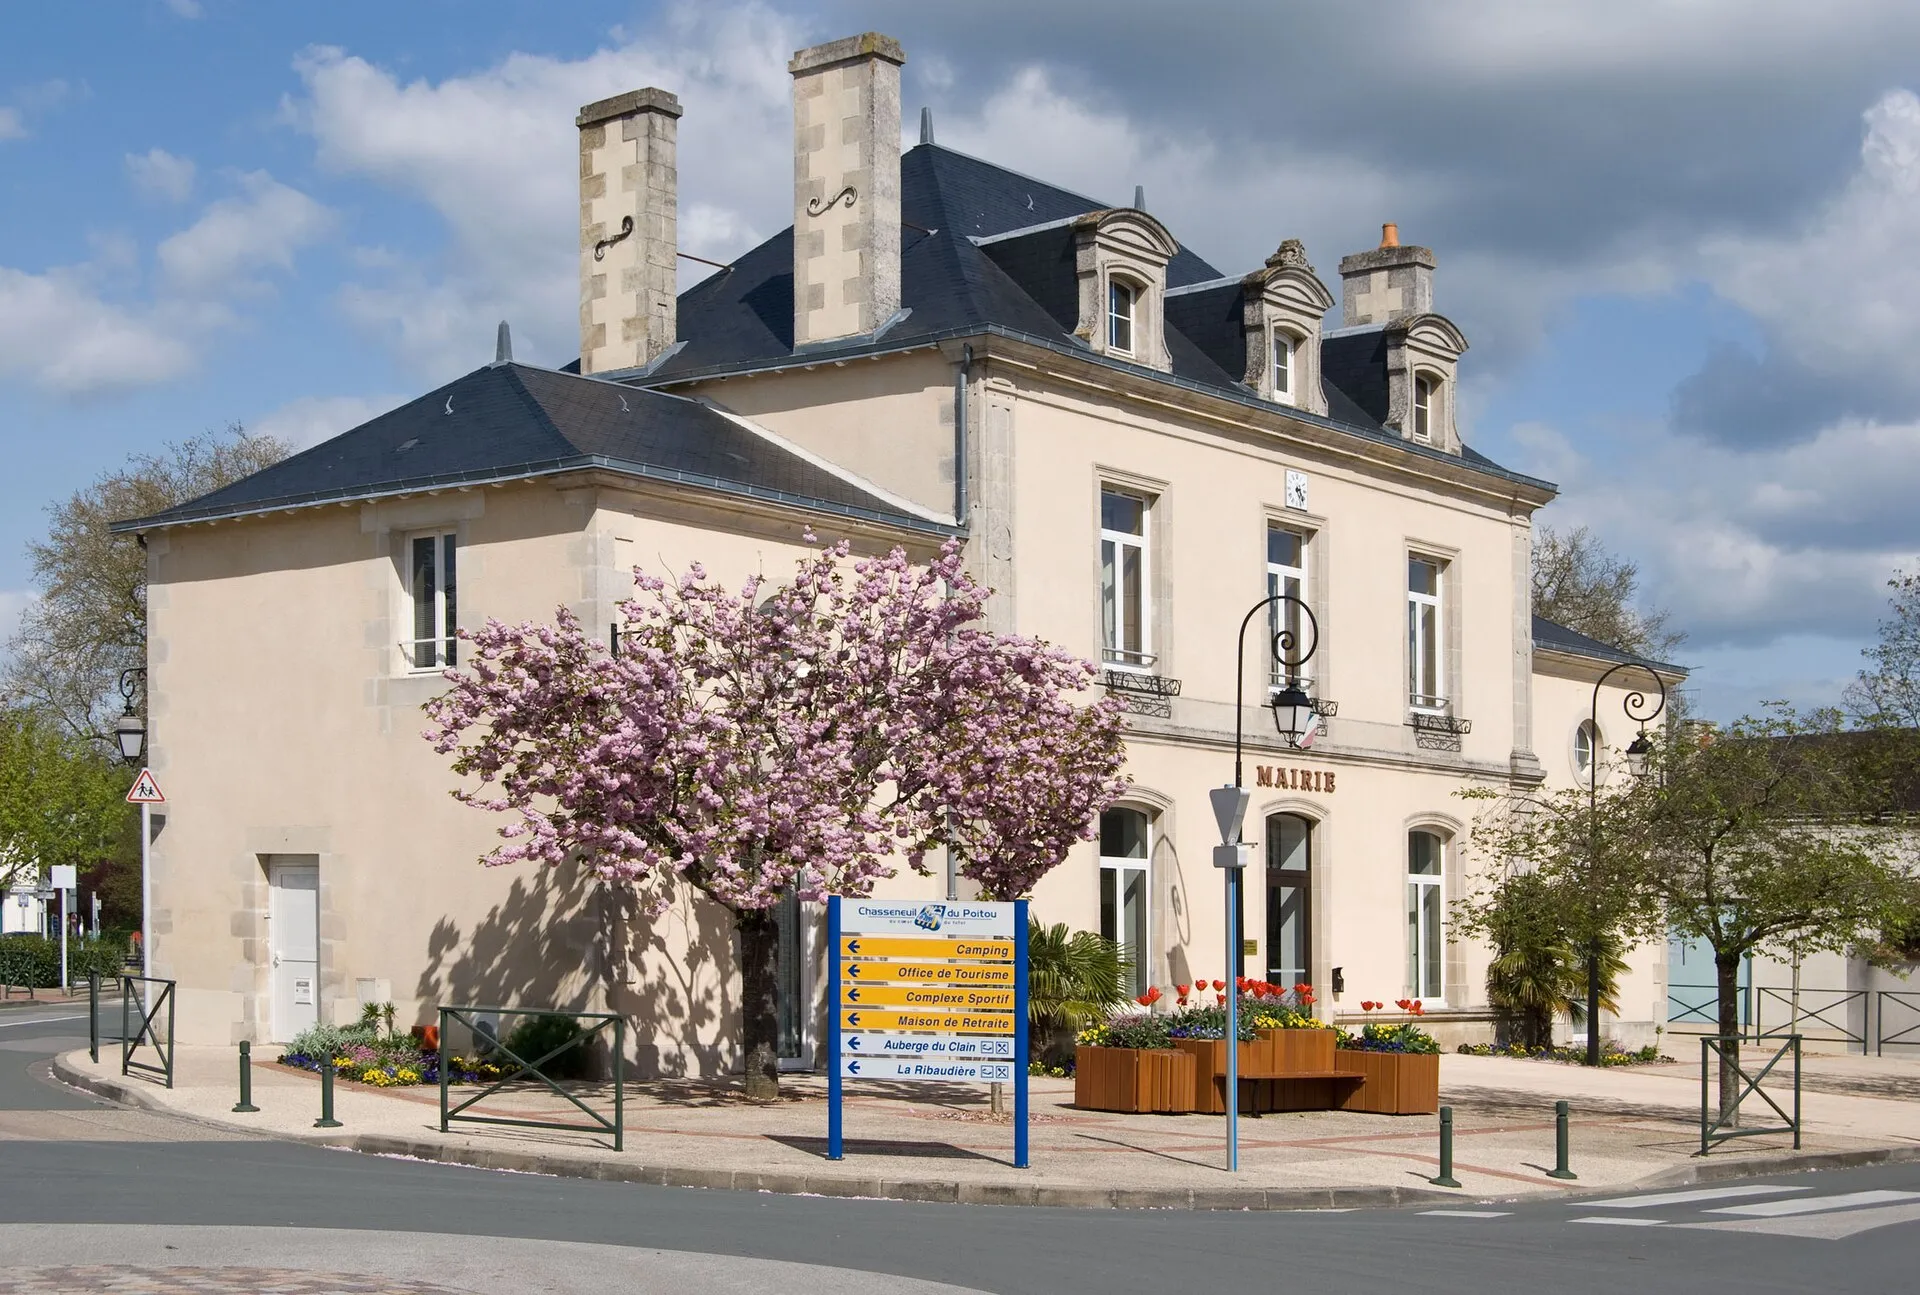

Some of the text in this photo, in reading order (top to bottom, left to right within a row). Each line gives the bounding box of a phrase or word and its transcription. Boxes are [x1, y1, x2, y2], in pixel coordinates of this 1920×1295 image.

[1256, 765, 1336, 793] MAIRIE
[858, 907, 997, 918] Chasseneuil du Poitou
[956, 945, 1009, 957] Camping
[898, 967, 1009, 979] Office de Tourisme
[906, 992, 1009, 1005] Complexe Sportif
[898, 1016, 1009, 1028] Maison de Retraite
[884, 1040, 976, 1052] Auberge du Clain
[897, 1064, 976, 1076] La Ribaudière
